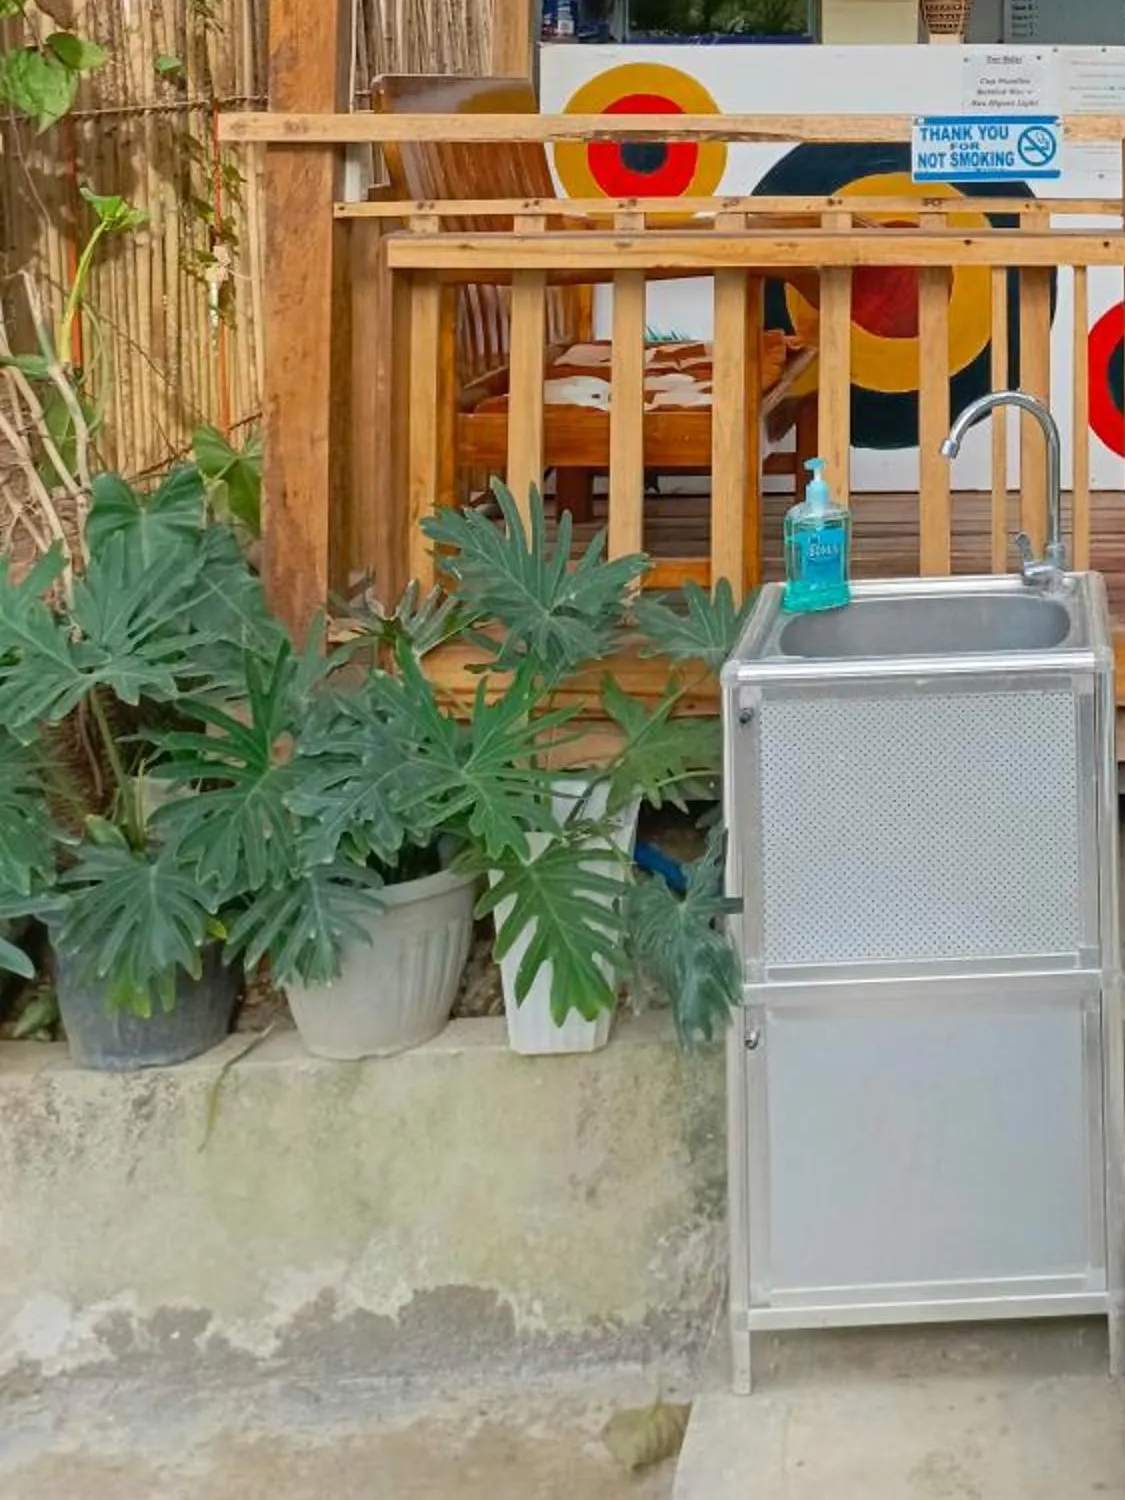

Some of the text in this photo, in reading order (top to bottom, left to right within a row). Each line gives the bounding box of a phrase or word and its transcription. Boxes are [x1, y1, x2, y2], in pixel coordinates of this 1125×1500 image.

[920, 125, 1009, 142] THANK YOU
[950, 142, 980, 150] FOR
[917, 151, 1015, 168] NOT SMOKING
